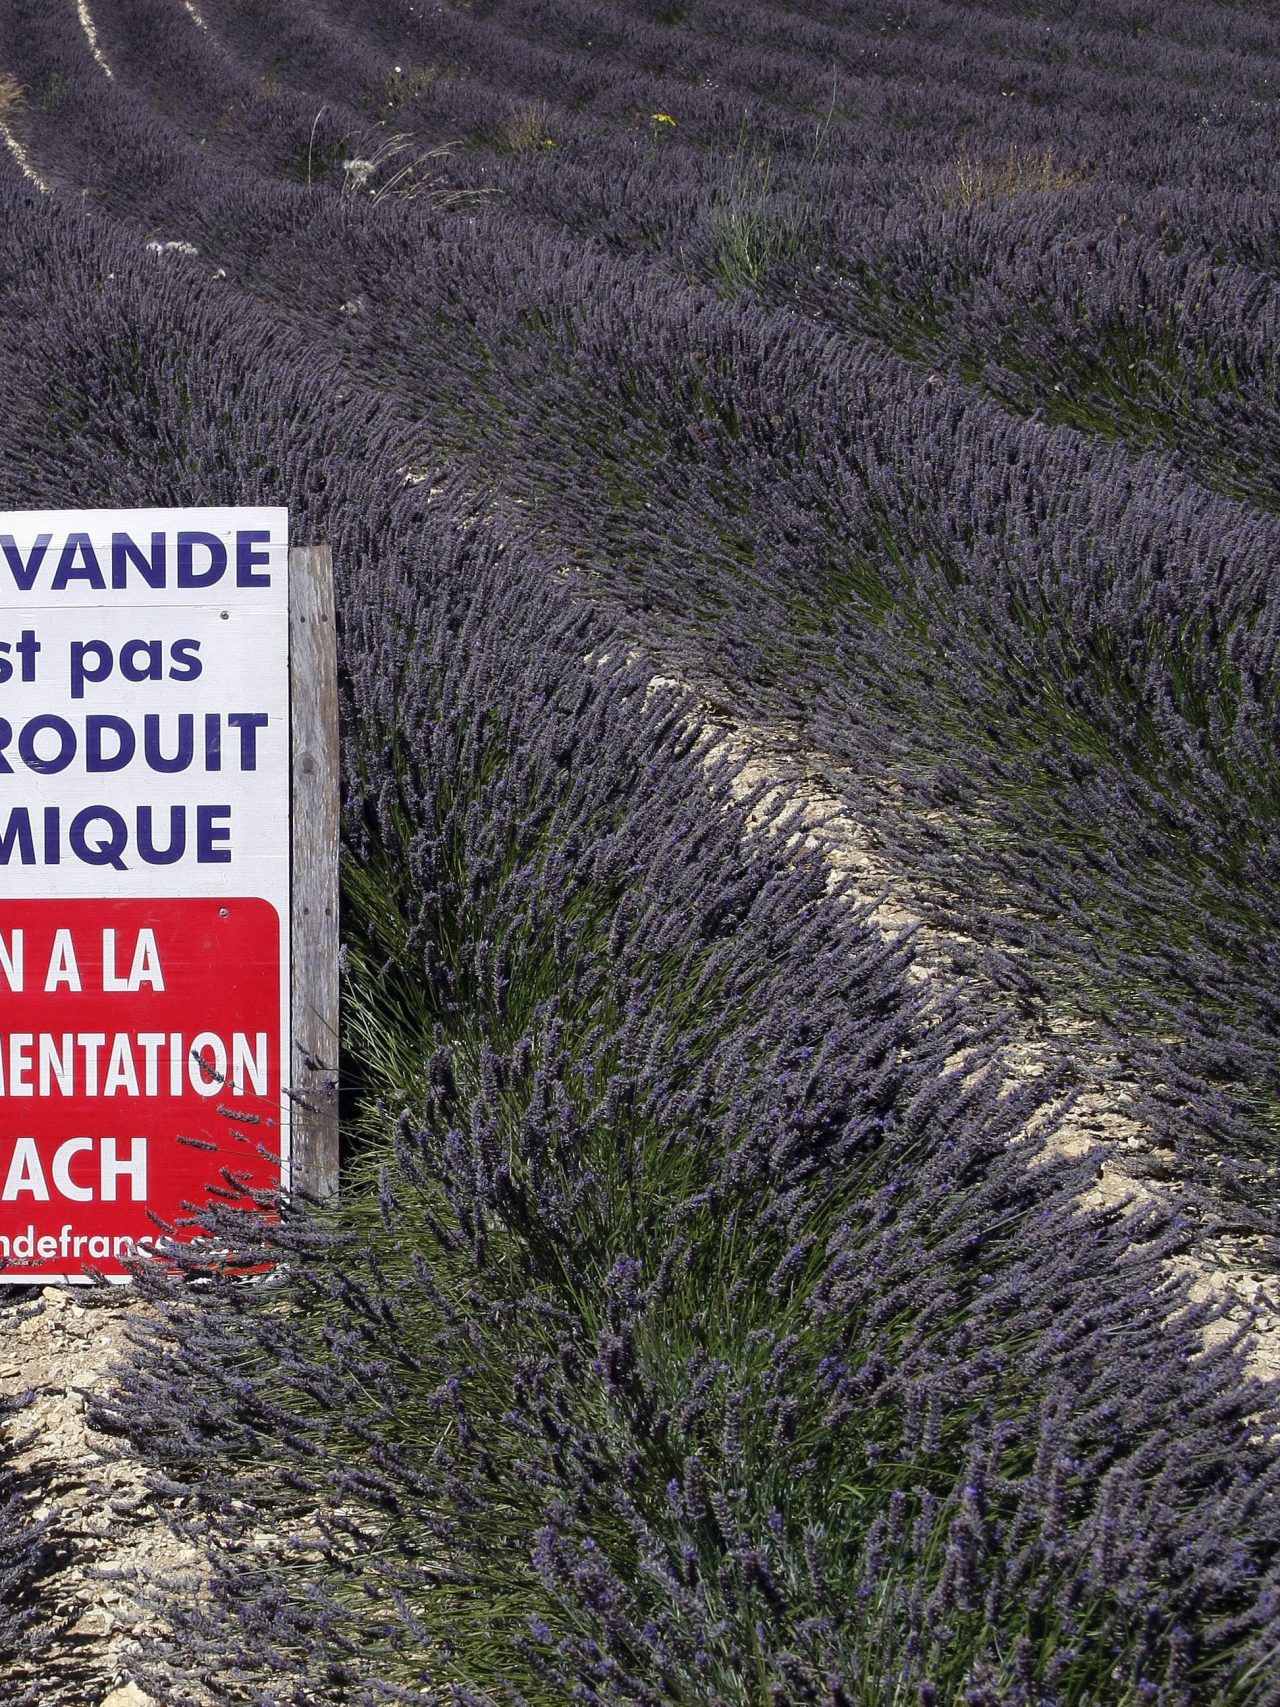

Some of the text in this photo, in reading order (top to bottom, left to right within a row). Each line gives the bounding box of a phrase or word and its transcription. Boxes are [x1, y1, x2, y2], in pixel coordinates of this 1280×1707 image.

[70, 638, 202, 699] pas
[44, 928, 82, 992] A
[103, 928, 165, 992] LA
